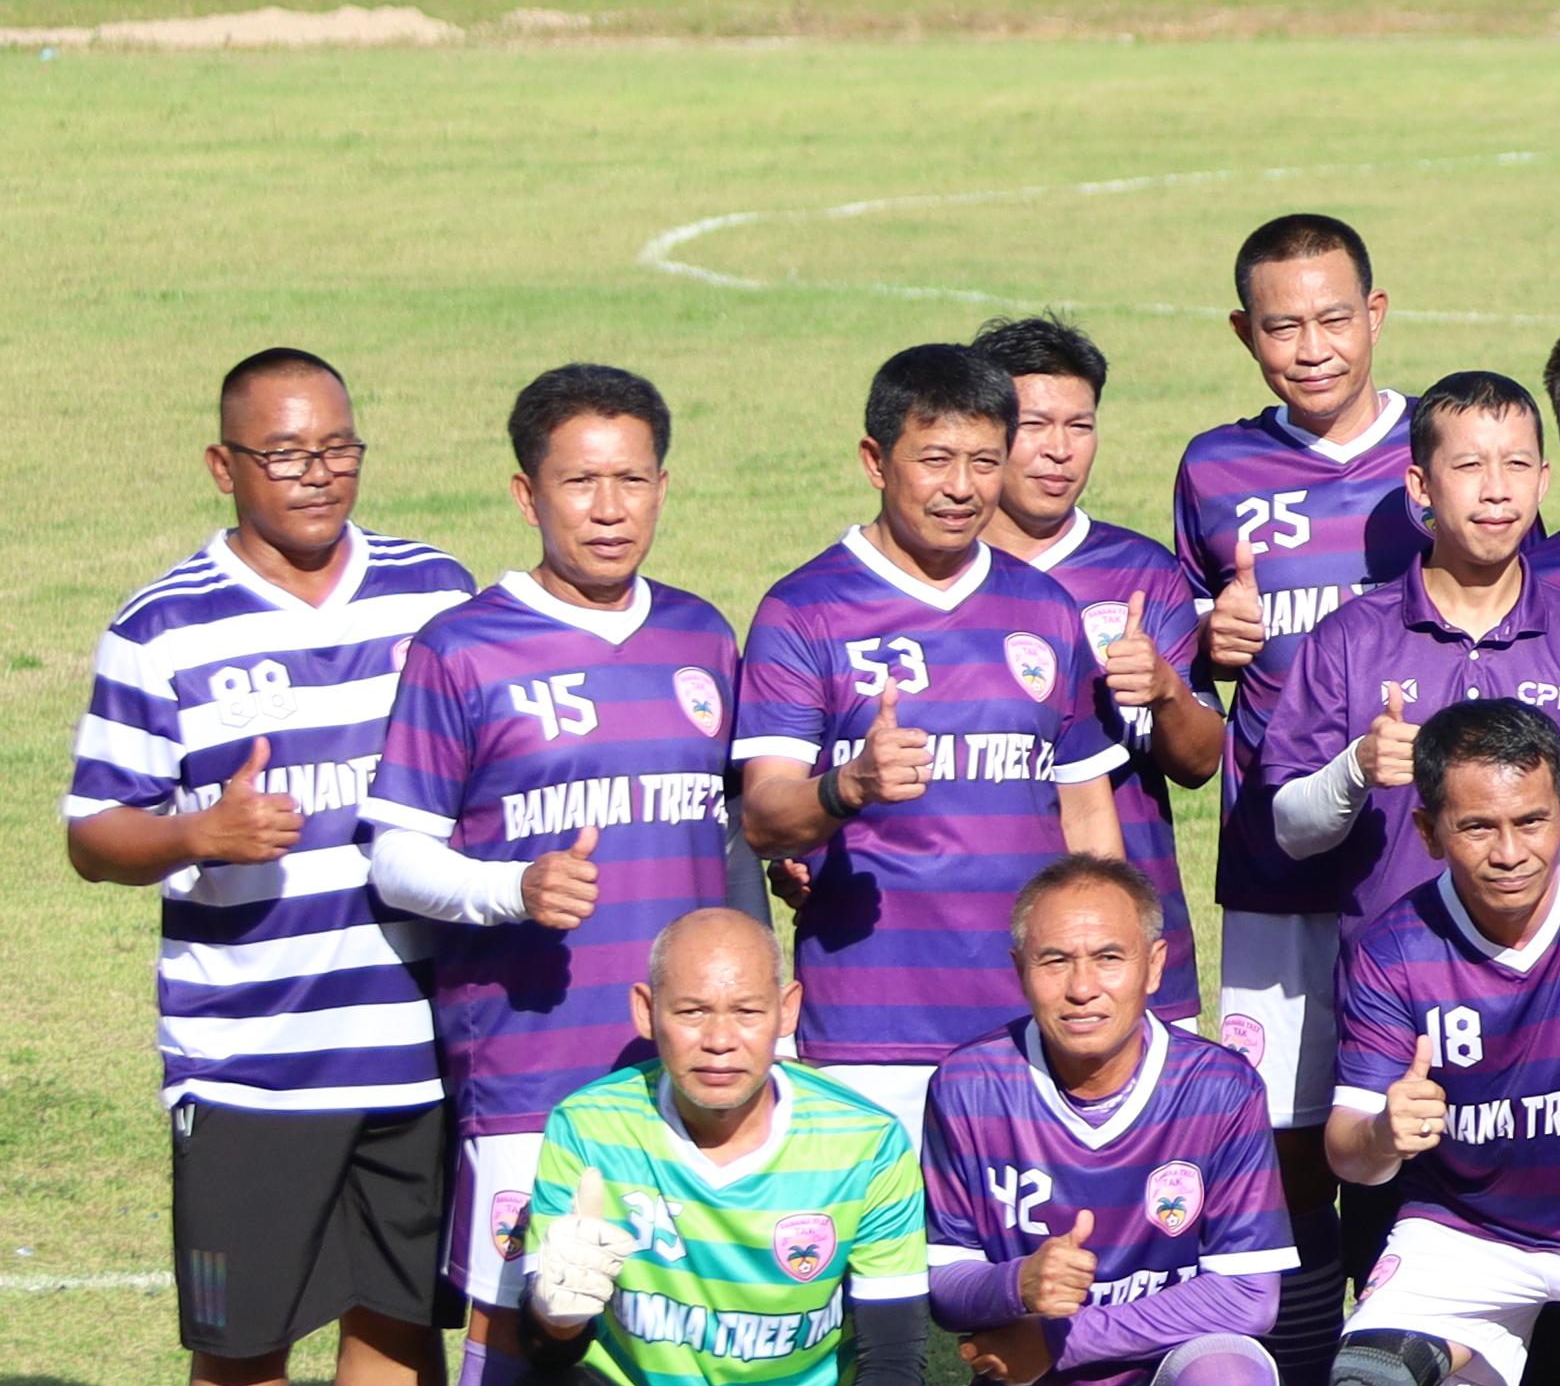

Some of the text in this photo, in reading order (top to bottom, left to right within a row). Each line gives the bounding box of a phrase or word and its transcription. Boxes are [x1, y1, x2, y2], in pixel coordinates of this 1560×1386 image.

[1235, 489, 1312, 555] 25
[210, 659, 298, 728] 88
[845, 636, 931, 697] 53
[509, 672, 599, 741] 45
[966, 734, 1036, 783] TREE
[504, 775, 632, 841] BANANA
[637, 773, 708, 825] TREE
[1233, 1026, 1248, 1037] TAK
[1424, 1004, 1484, 1069] 18
[621, 1190, 688, 1264] 35
[987, 1168, 1053, 1236] 42
[712, 1310, 804, 1363] TREE
